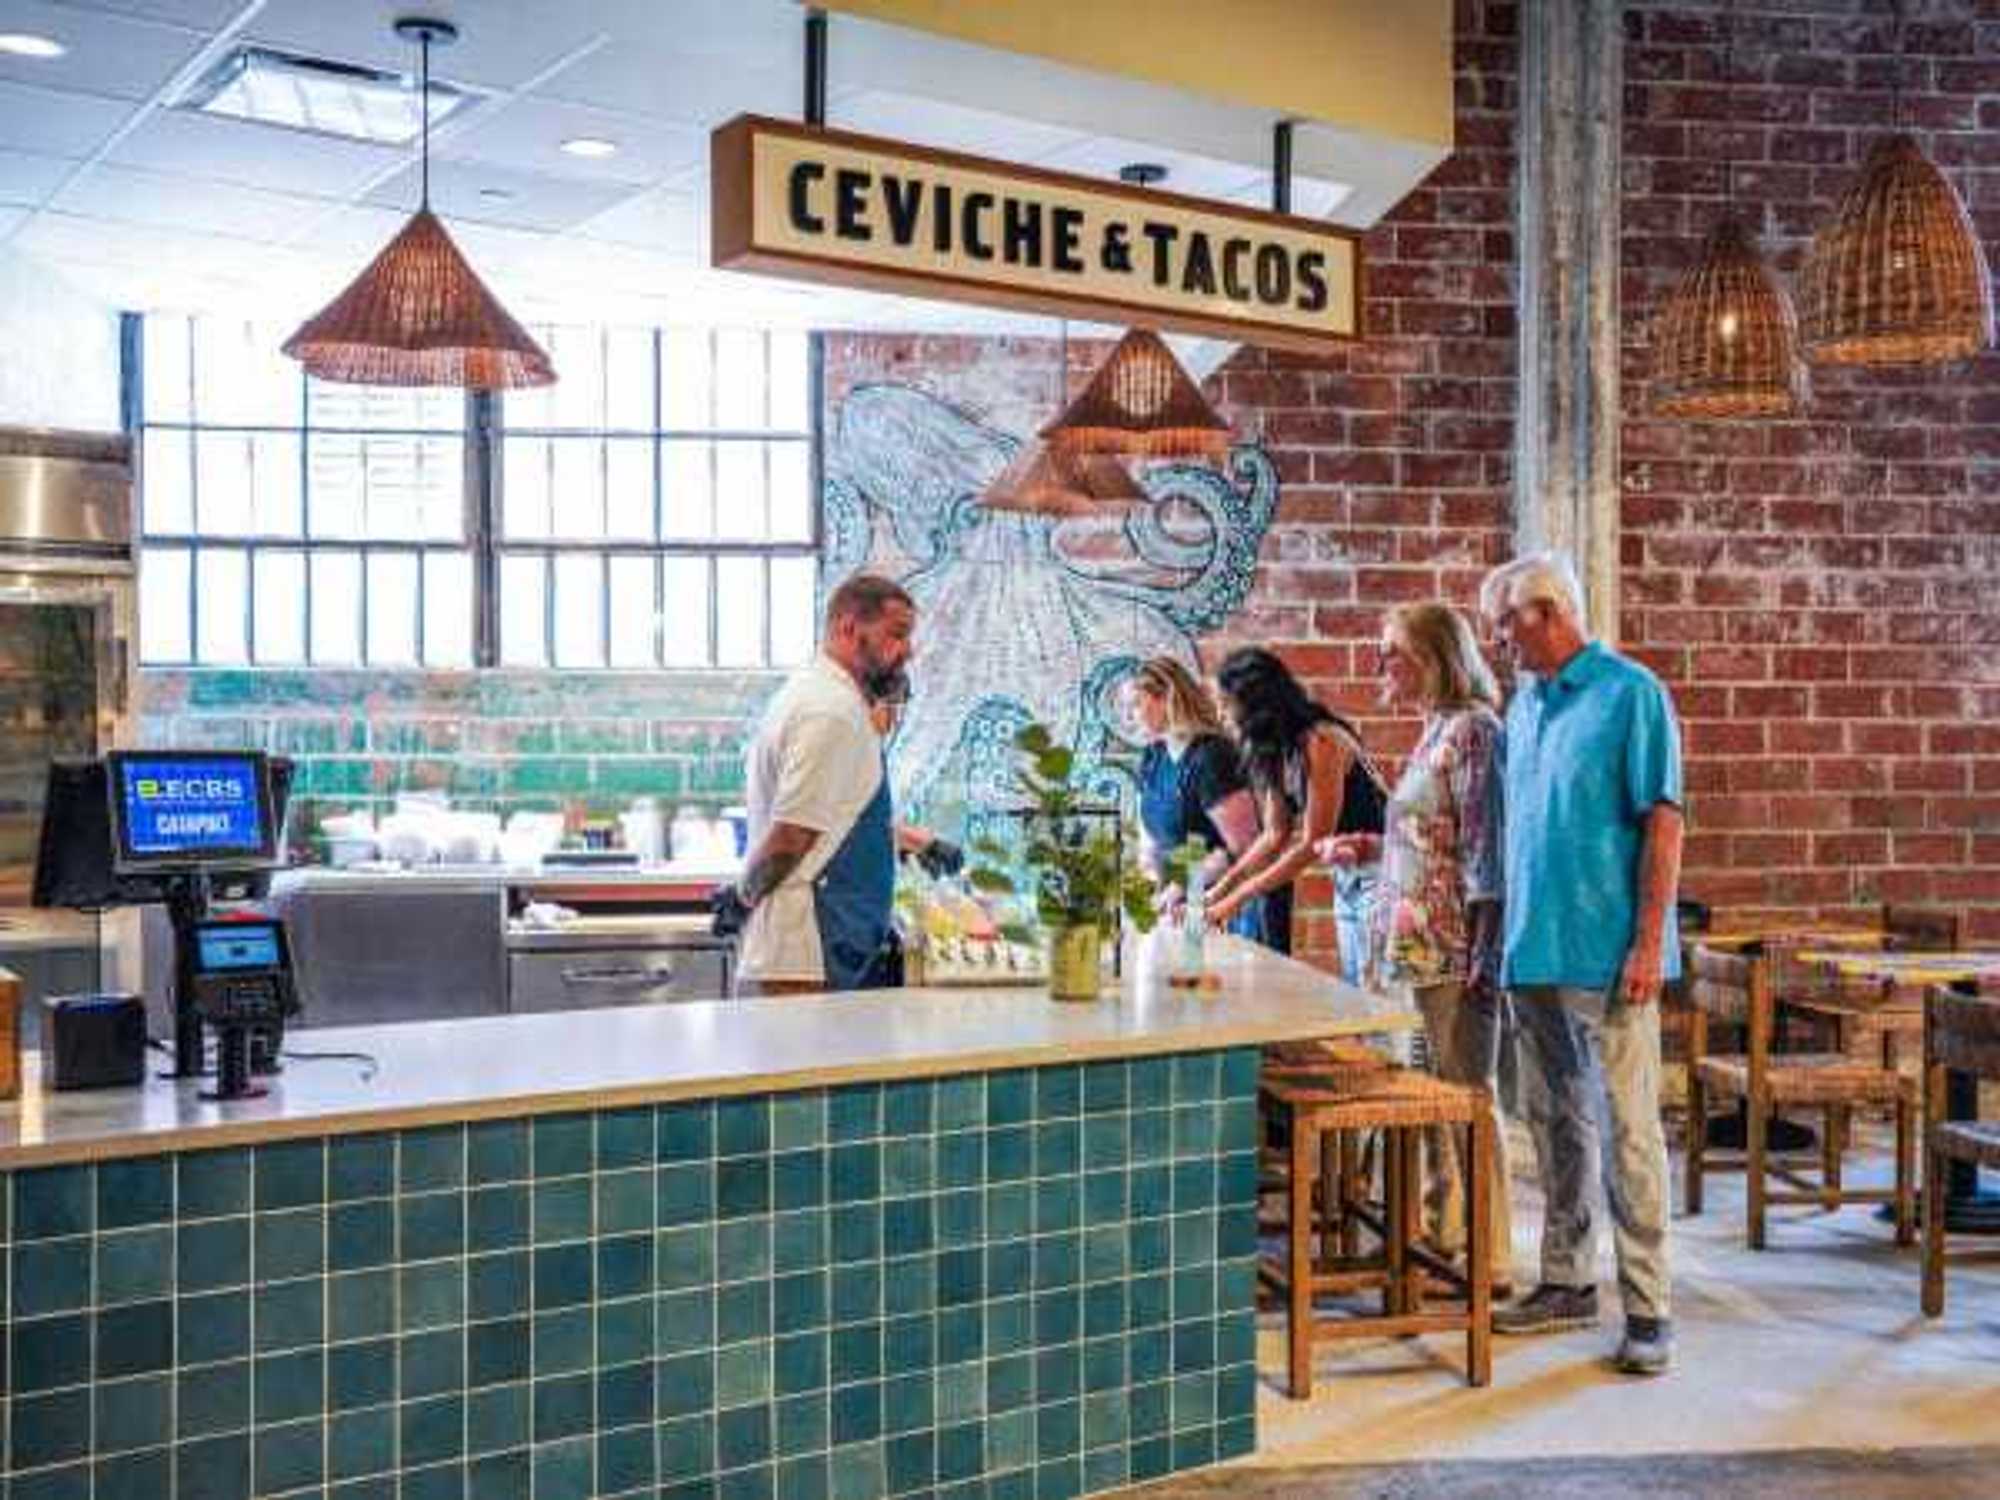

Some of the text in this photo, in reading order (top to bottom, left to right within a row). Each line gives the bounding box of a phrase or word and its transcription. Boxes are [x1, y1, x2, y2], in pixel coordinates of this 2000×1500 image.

[788, 161, 1328, 312] CEVICHE & TACOS
